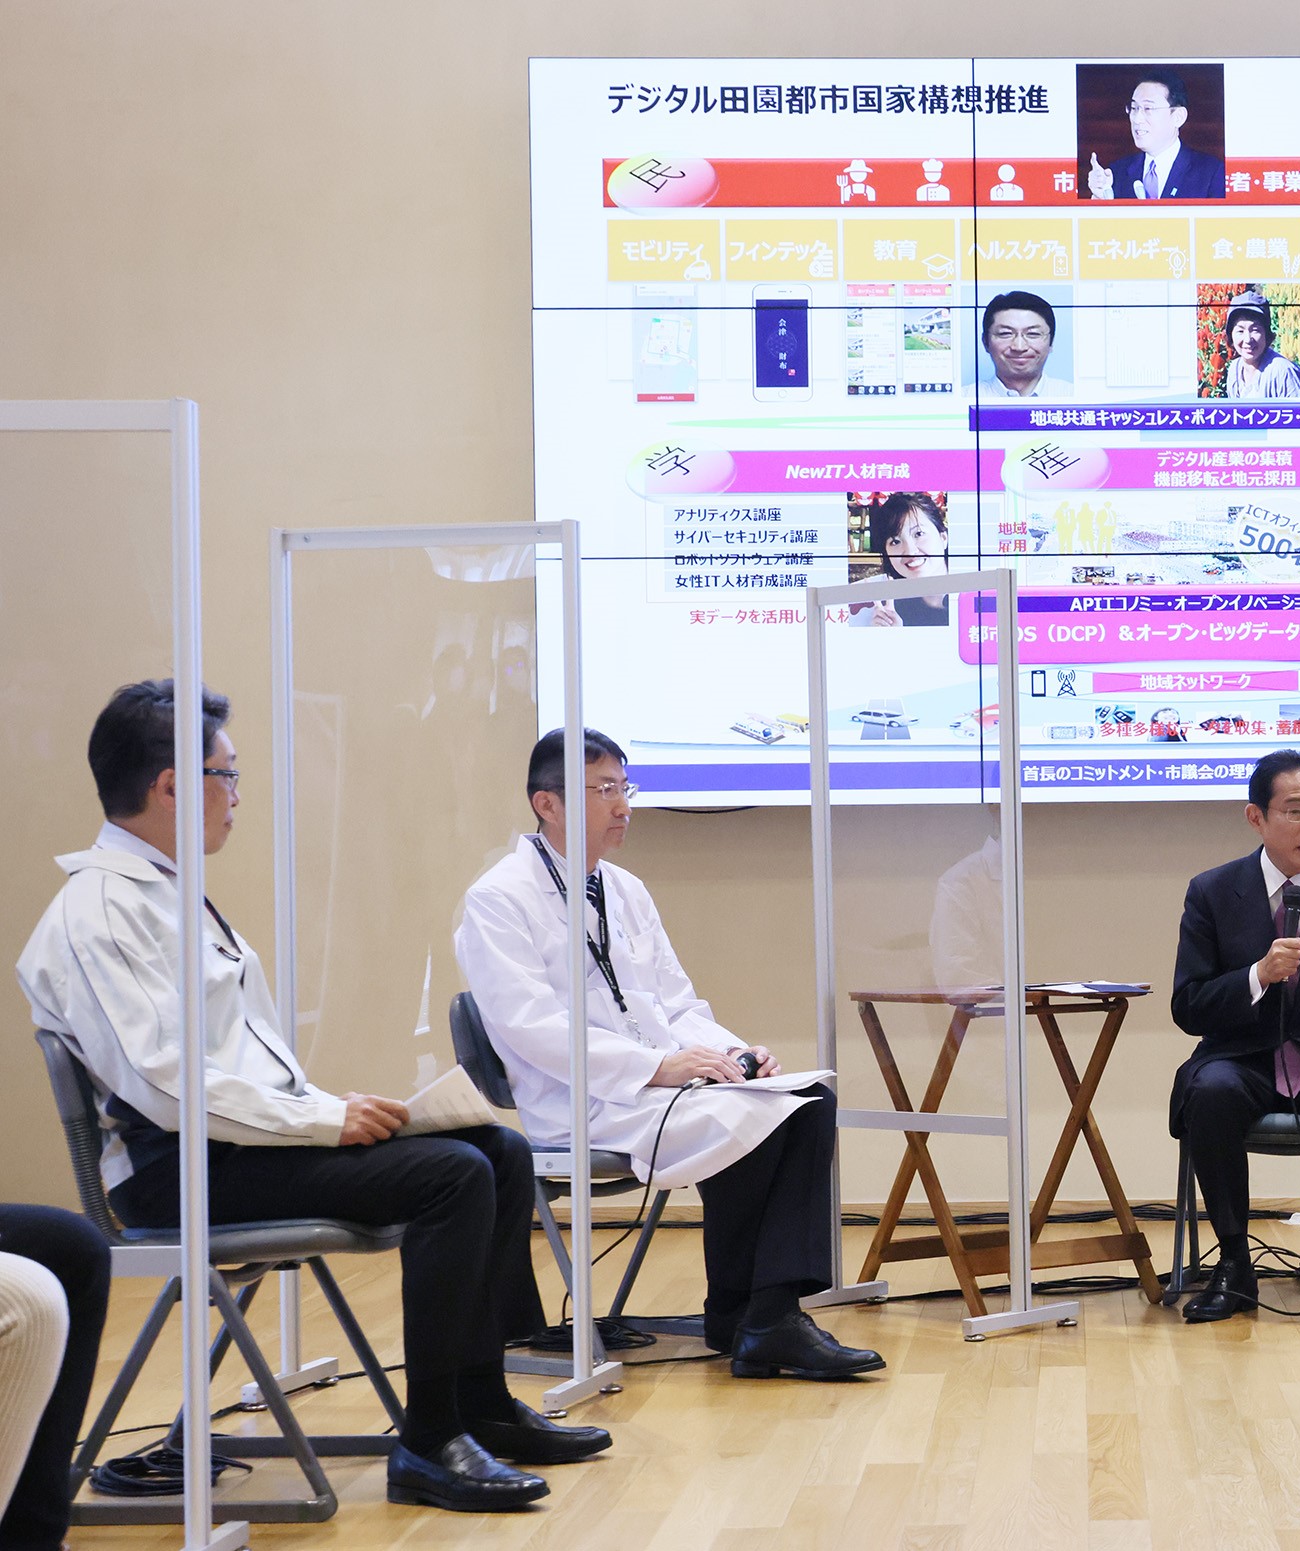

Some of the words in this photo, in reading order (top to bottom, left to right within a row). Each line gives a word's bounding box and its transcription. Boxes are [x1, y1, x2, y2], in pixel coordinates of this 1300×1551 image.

[607, 82, 1050, 115] デジタル田園都市国家構想推進
[628, 158, 686, 194] 民
[1053, 171, 1078, 193] 市
[621, 239, 704, 262] モビリティ
[729, 239, 829, 262] フィンテック
[873, 239, 918, 261] 教育
[967, 239, 1059, 261] ヘルスケア
[1087, 236, 1179, 260] エネルギー
[1211, 237, 1289, 260] 食・農業
[645, 446, 696, 477] 学
[1021, 442, 1081, 480] 産
[1156, 450, 1293, 467] デジタル産業の集積
[785, 463, 911, 480] NewIT人材育成
[1153, 470, 1297, 487] 機能移転と地元採用
[674, 507, 782, 522] アナリティクス講座
[674, 529, 819, 544] サイバーセキュリティ講座
[998, 521, 1028, 536] 地域
[998, 538, 1028, 553] 雇用
[674, 552, 814, 566] ロボットソフトウェア講座
[675, 573, 808, 588] 女性IT人材育成講座
[1140, 673, 1252, 690] 地域ネットワーク
